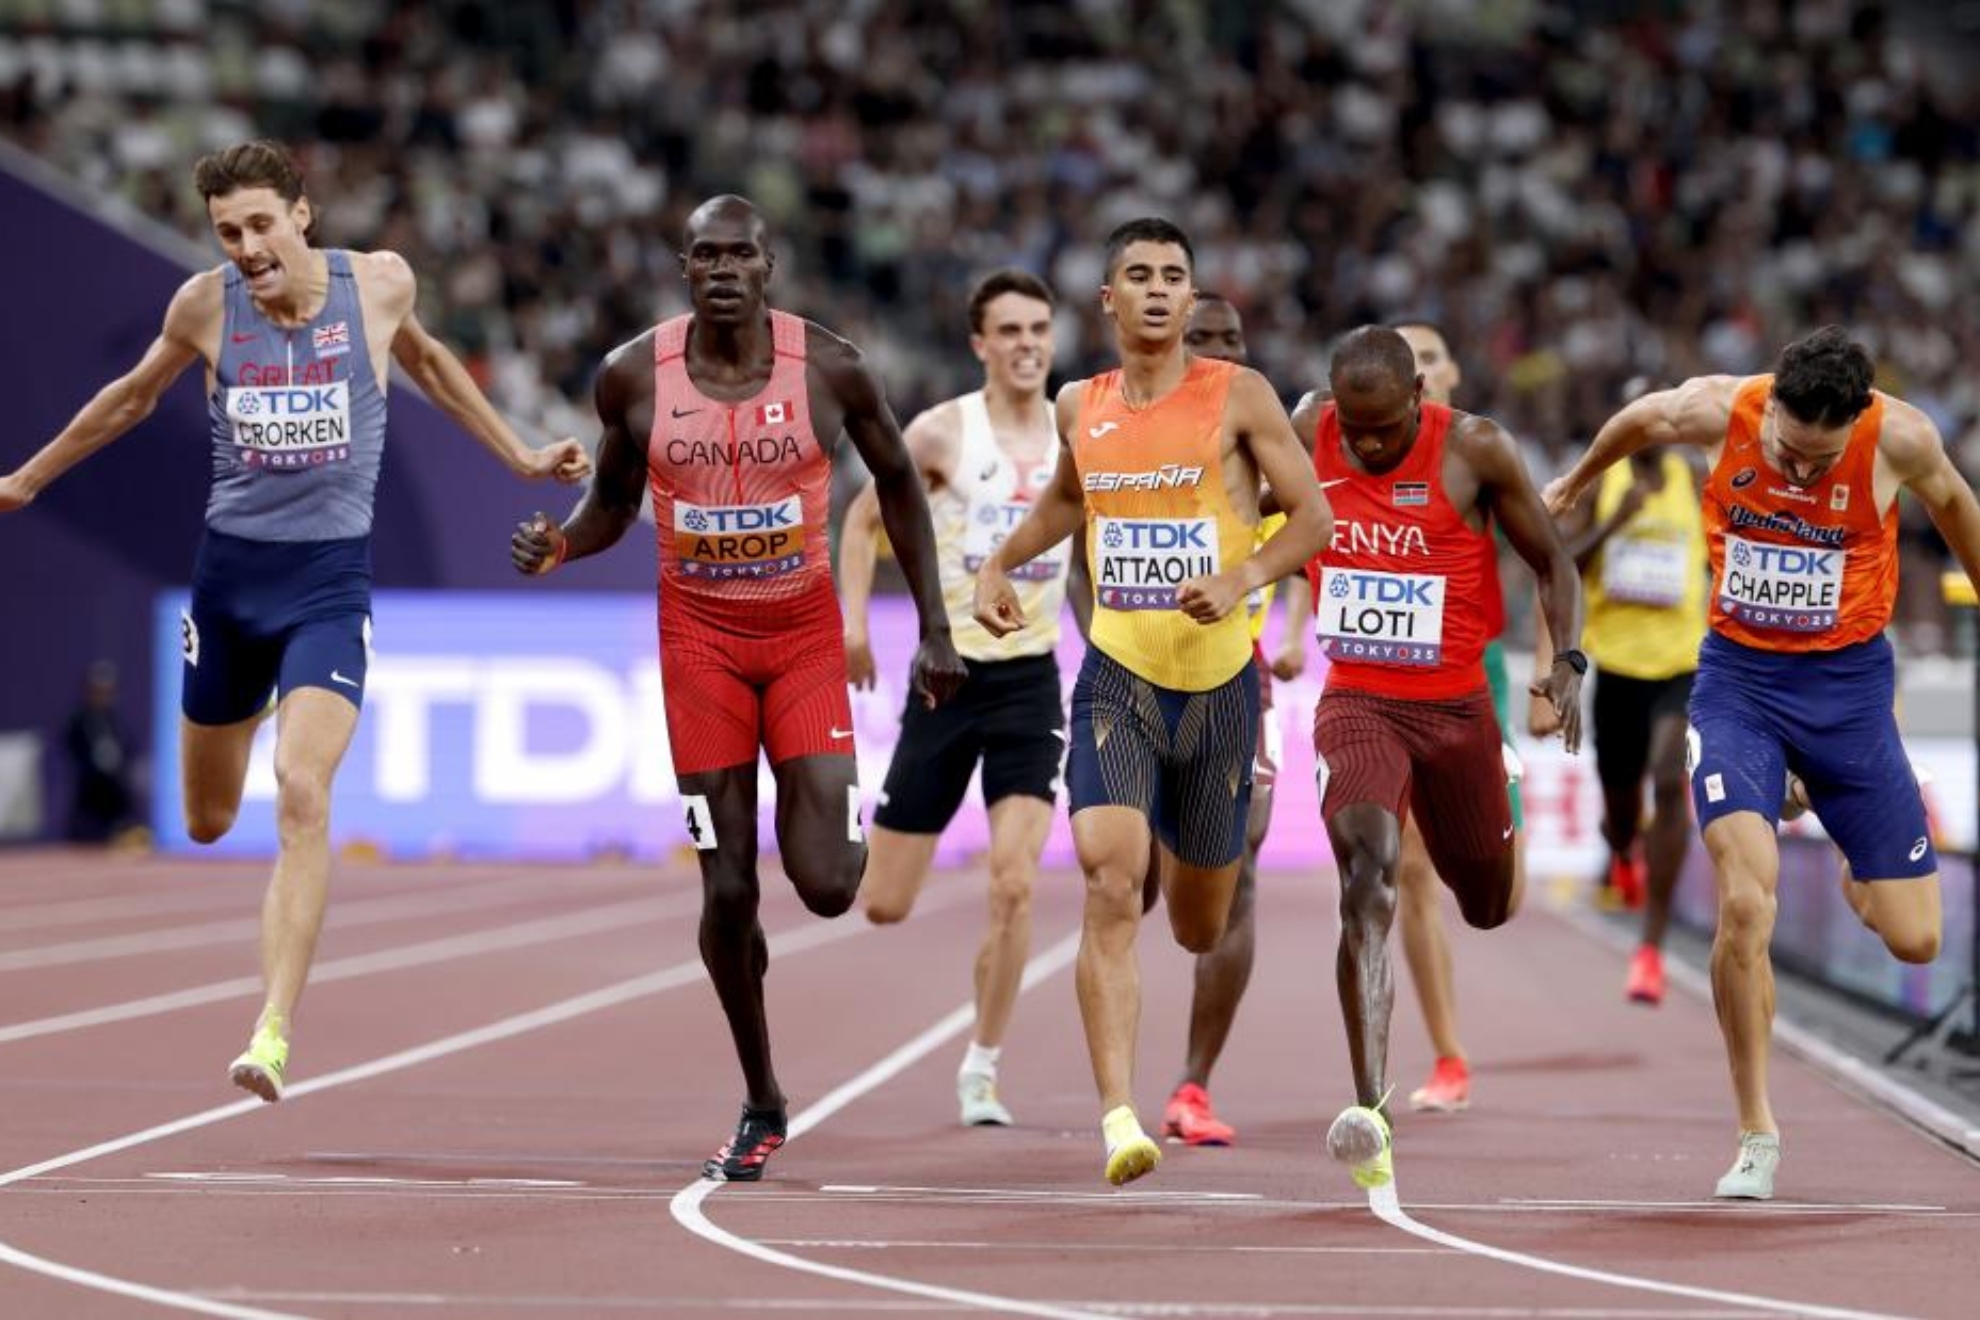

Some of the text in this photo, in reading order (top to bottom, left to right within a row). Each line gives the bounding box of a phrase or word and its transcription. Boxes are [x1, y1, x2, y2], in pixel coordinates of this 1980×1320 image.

[239, 358, 340, 386] GREAT
[260, 388, 338, 413] TDK
[239, 417, 344, 446] CRORKEN
[667, 436, 802, 465] CANADA
[1084, 464, 1204, 492] ESPAÑA
[708, 503, 792, 531] TDK
[693, 533, 788, 560] AROP
[1122, 522, 1207, 549] TDK
[1331, 520, 1430, 556] ENYA
[1752, 545, 1833, 576] TDK
[1351, 575, 1435, 606] TDK
[1728, 571, 1835, 607] CHAPPLE
[1339, 606, 1414, 638] LOTI
[687, 805, 702, 843] 4
